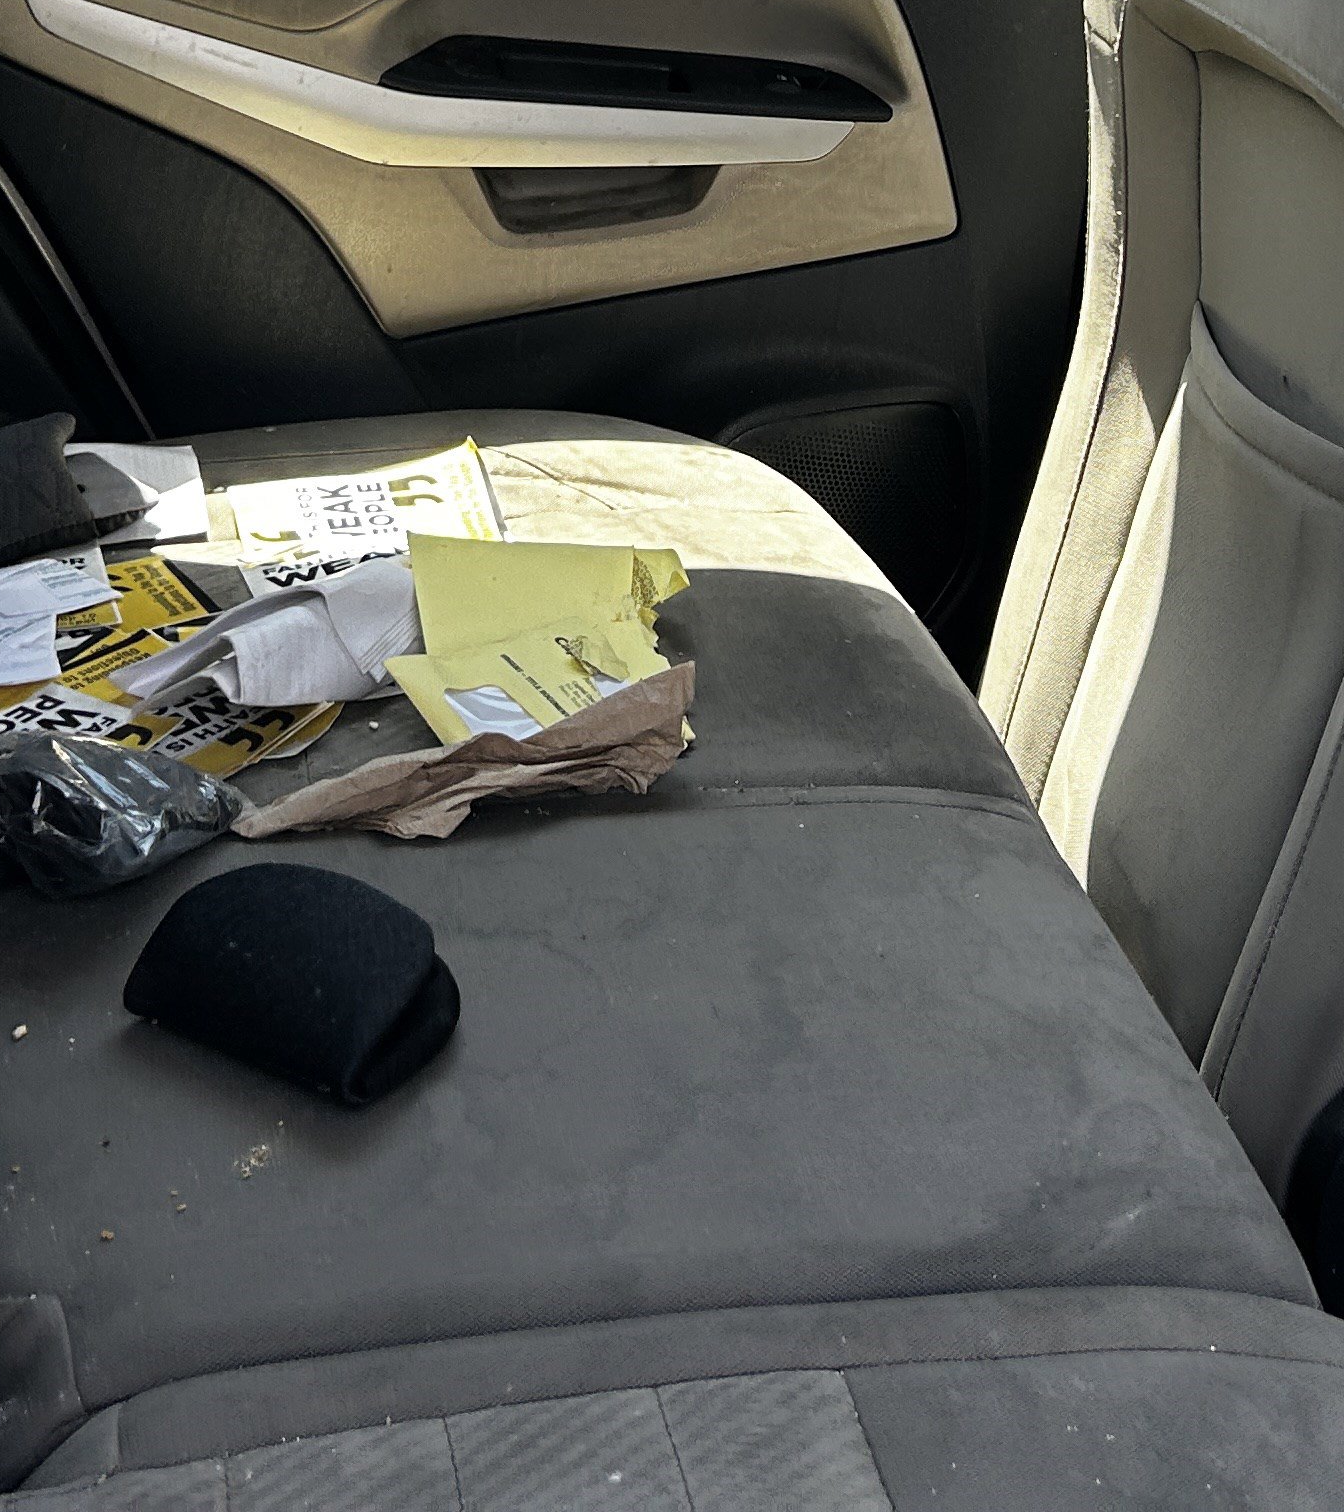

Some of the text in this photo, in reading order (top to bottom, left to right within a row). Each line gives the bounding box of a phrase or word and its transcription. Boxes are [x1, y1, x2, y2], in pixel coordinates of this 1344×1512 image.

[317, 484, 366, 536] EAK
[79, 647, 141, 676] Objections
[165, 738, 194, 753] IS
